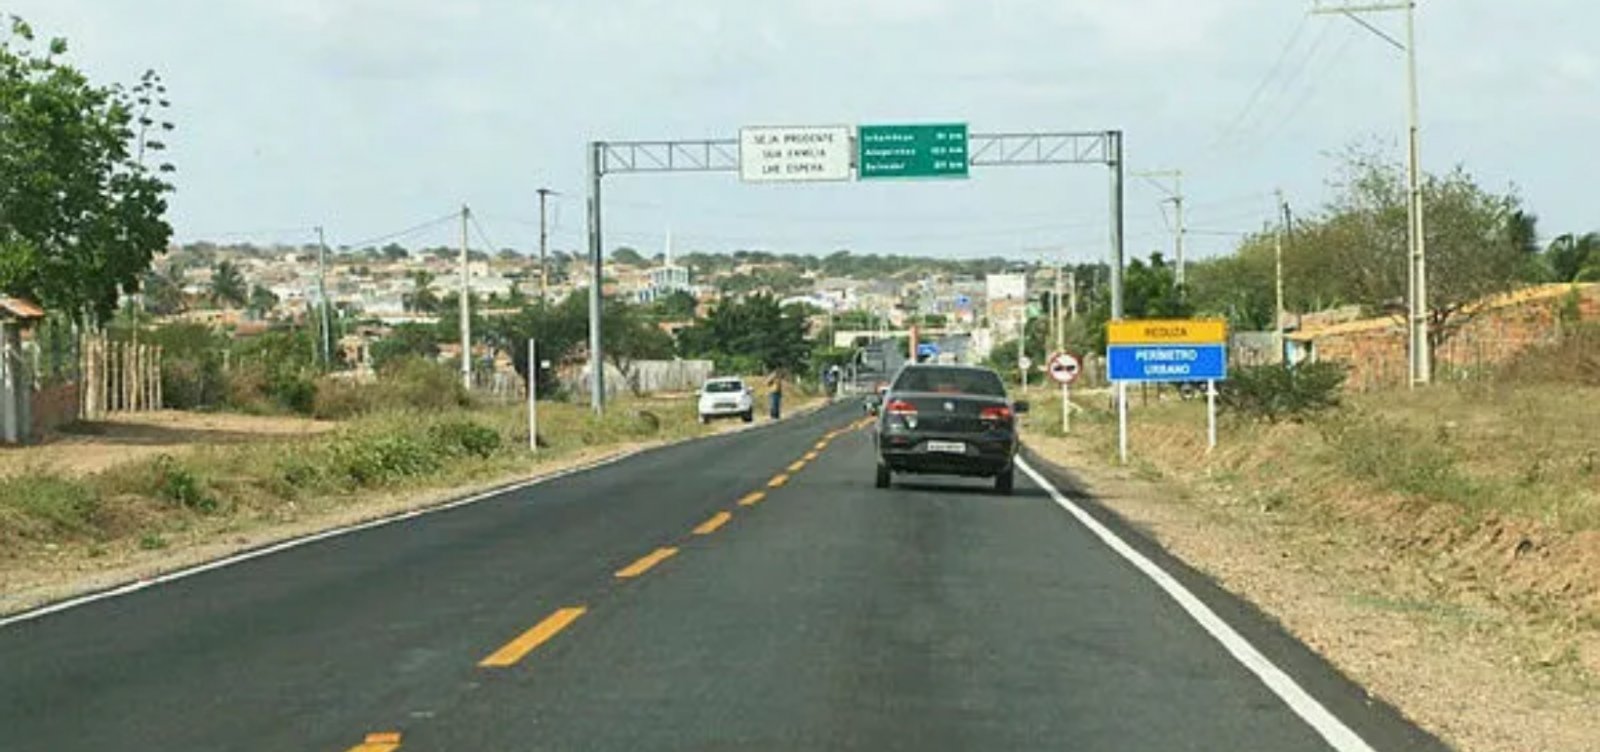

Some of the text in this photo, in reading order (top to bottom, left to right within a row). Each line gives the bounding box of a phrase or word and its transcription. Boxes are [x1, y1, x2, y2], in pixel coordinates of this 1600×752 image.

[753, 133, 832, 144] SEJA PRUDENTE
[786, 163, 824, 174] ESPERA
[1144, 327, 1188, 336] REDUZA
[1143, 363, 1190, 375] URBANO
